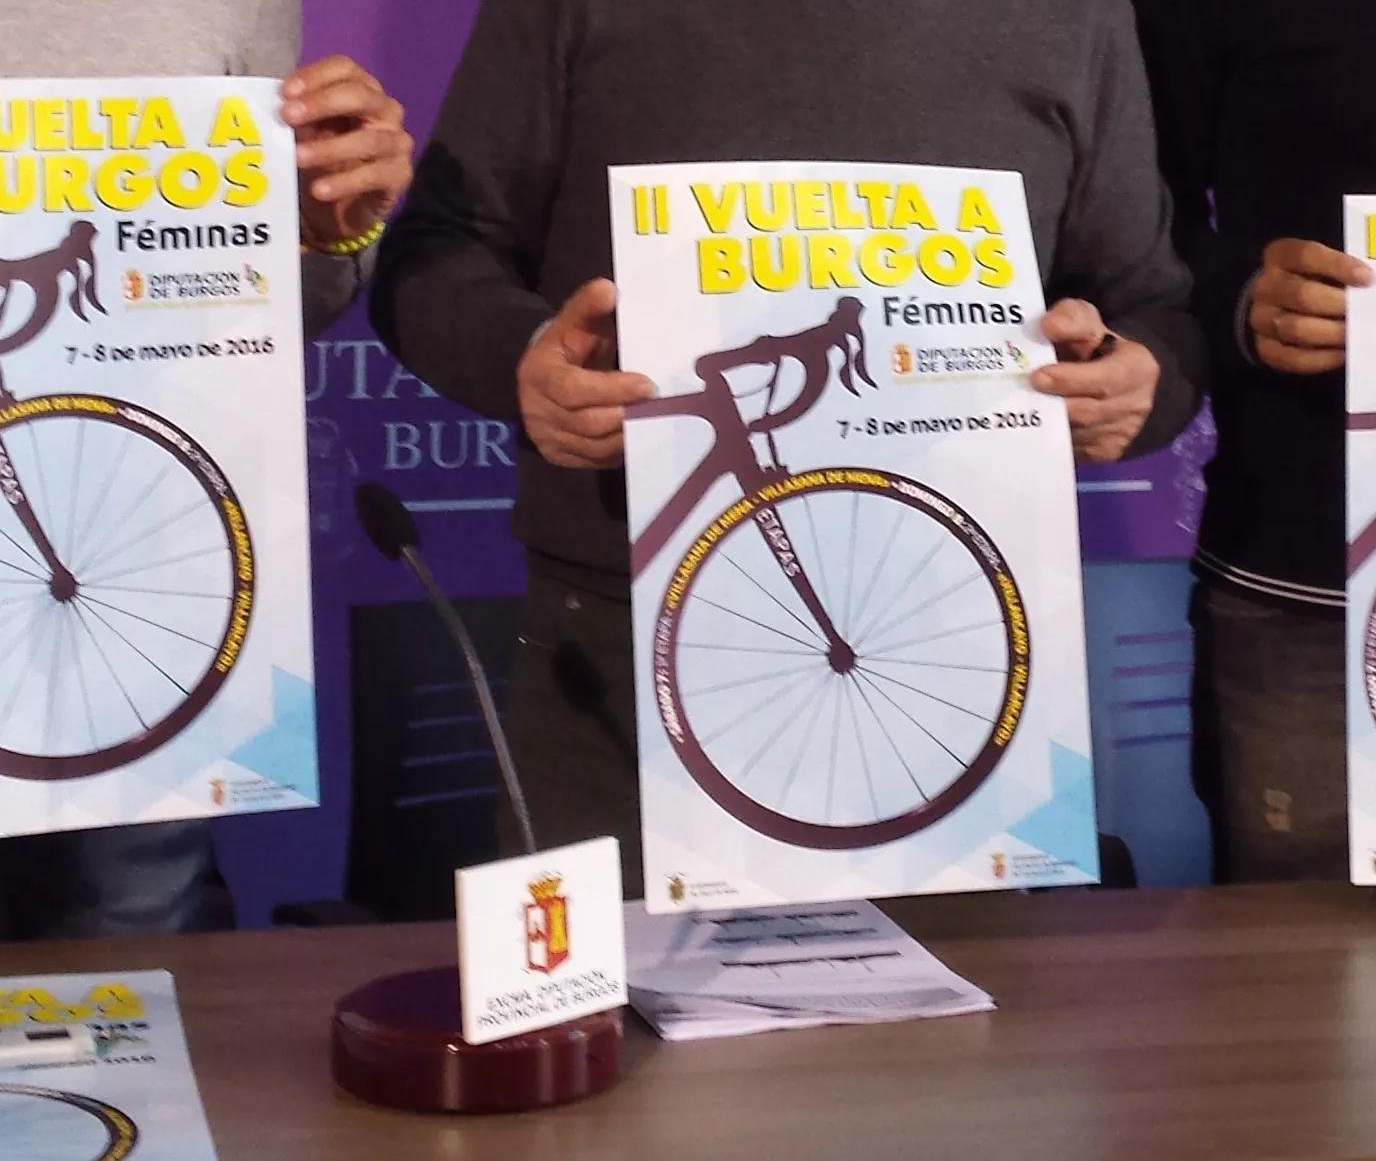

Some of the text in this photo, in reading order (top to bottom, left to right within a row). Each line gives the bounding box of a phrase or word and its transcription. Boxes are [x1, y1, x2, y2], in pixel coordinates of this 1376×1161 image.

[208, 94, 262, 148] A
[632, 180, 1003, 236] II VUELTA A
[117, 218, 270, 252] Féminas
[697, 233, 1015, 295] BURGOS
[151, 284, 240, 300] DE BURGOS
[883, 297, 1024, 326] Féminas
[227, 337, 274, 355] 2016
[918, 358, 1005, 373] DE BURGOS
[993, 410, 1042, 429] 2016
[383, 420, 516, 469] BUR
